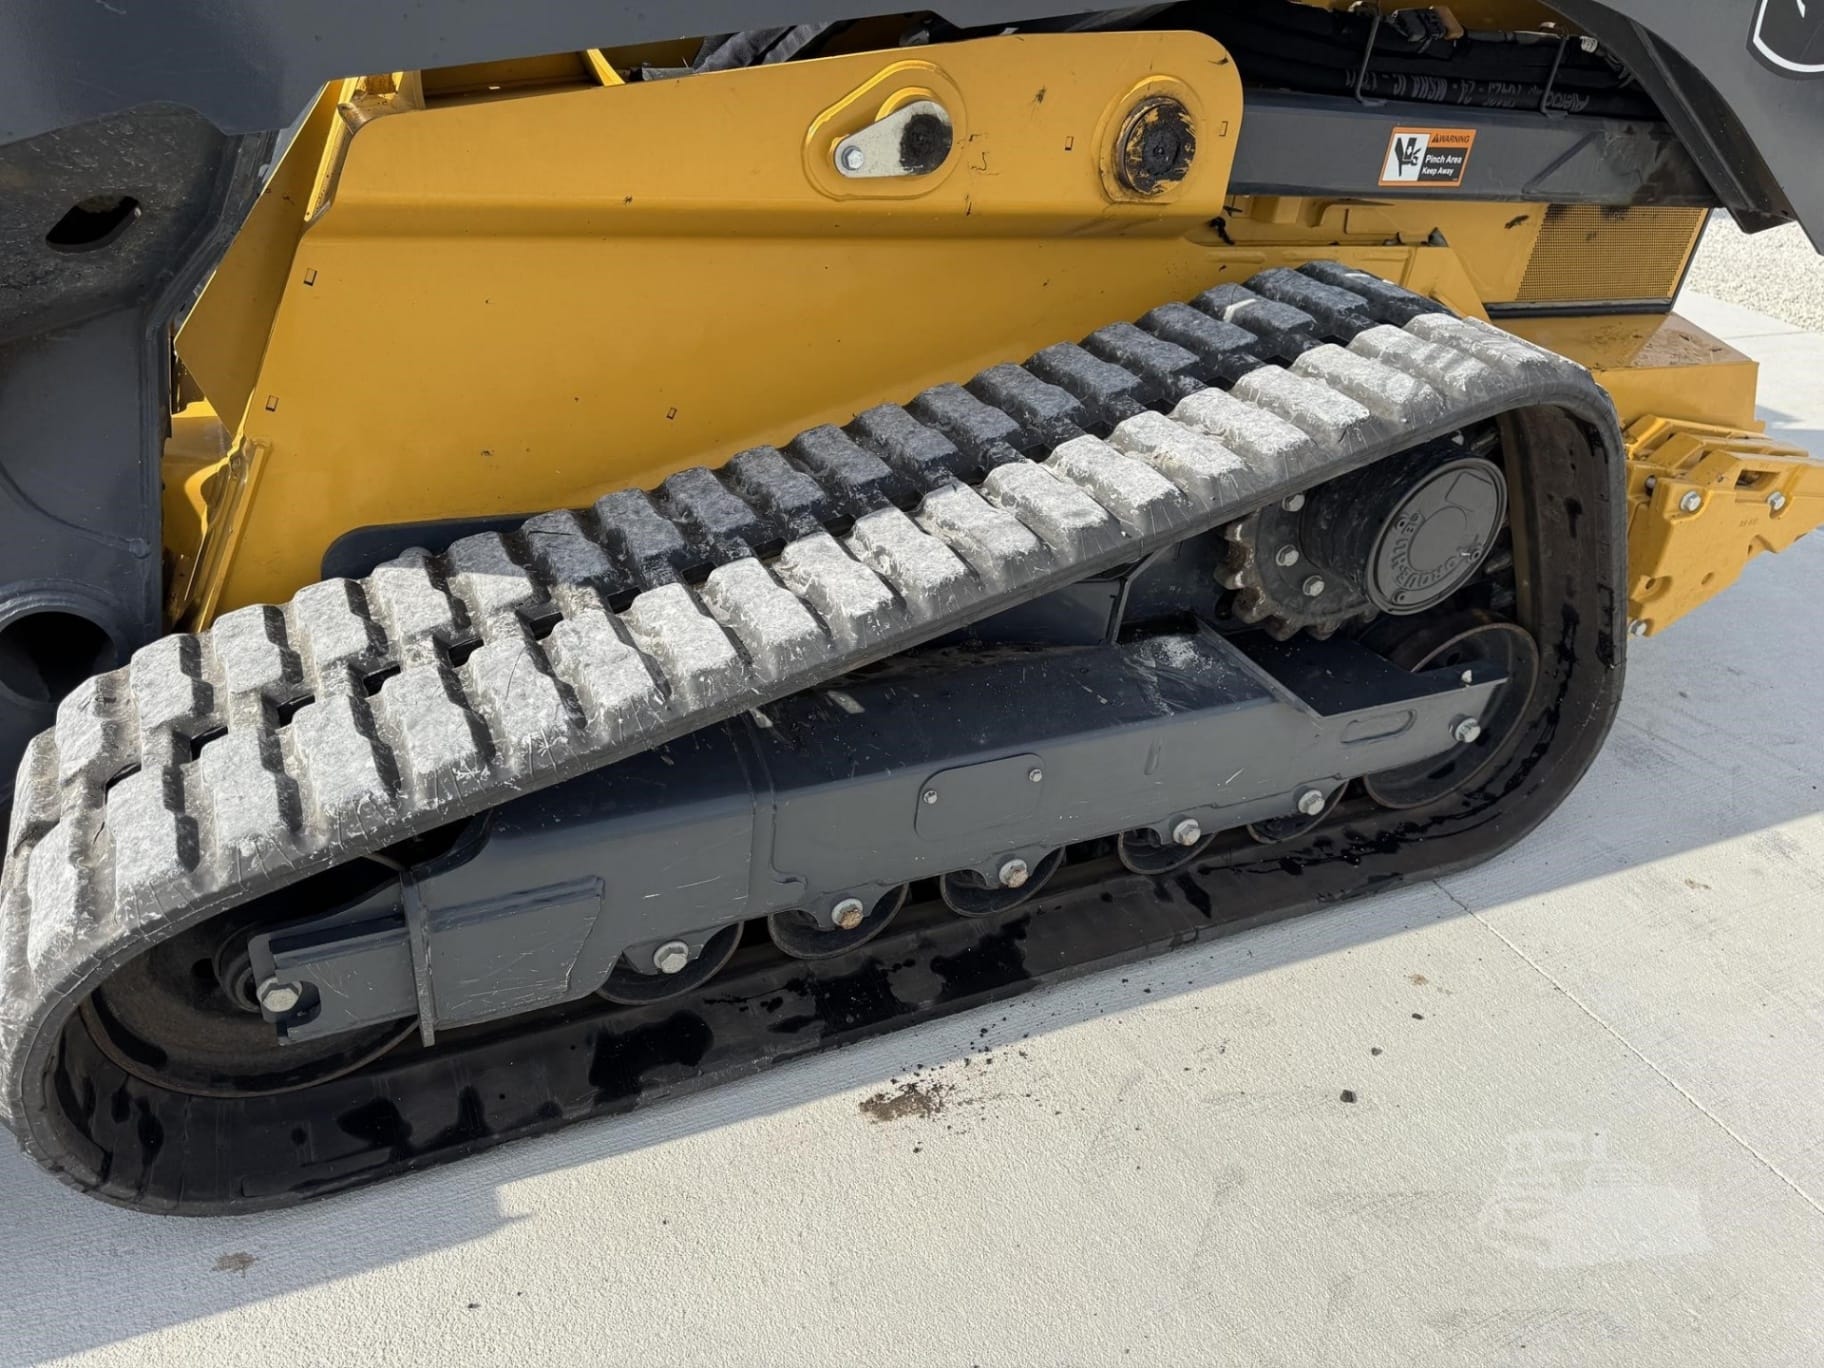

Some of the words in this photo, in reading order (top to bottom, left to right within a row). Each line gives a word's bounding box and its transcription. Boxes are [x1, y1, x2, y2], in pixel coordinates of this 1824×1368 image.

[1438, 135, 1470, 143] WARNING
[1425, 154, 1445, 164] Pinch
[1445, 155, 1462, 164] Area
[1422, 167, 1438, 176] Keep
[1437, 167, 1454, 177] Away
